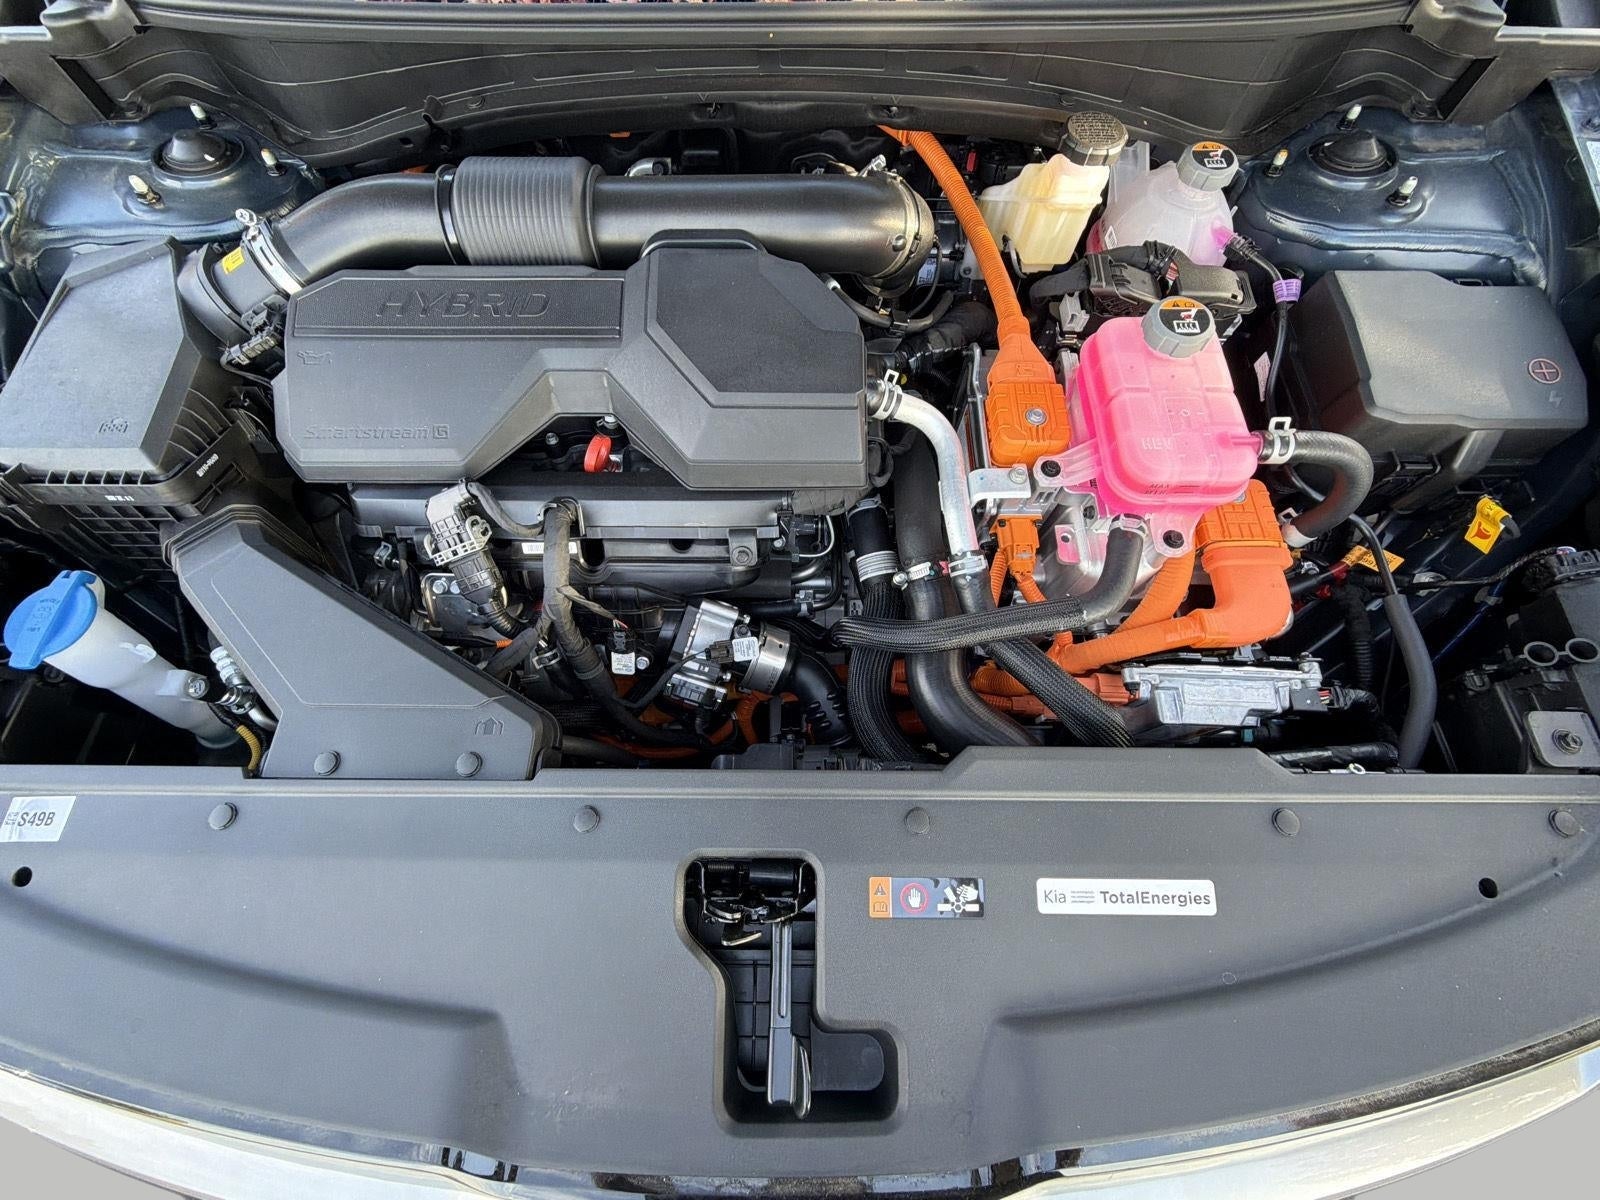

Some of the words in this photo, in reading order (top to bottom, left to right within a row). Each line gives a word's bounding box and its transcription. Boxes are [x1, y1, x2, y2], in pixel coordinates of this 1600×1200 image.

[376, 291, 550, 317] HYBRID
[304, 425, 430, 440] Smartstream
[17, 811, 56, 827] S49B
[1043, 889, 1067, 904] Kia
[1099, 890, 1211, 907] TotalEnergies
